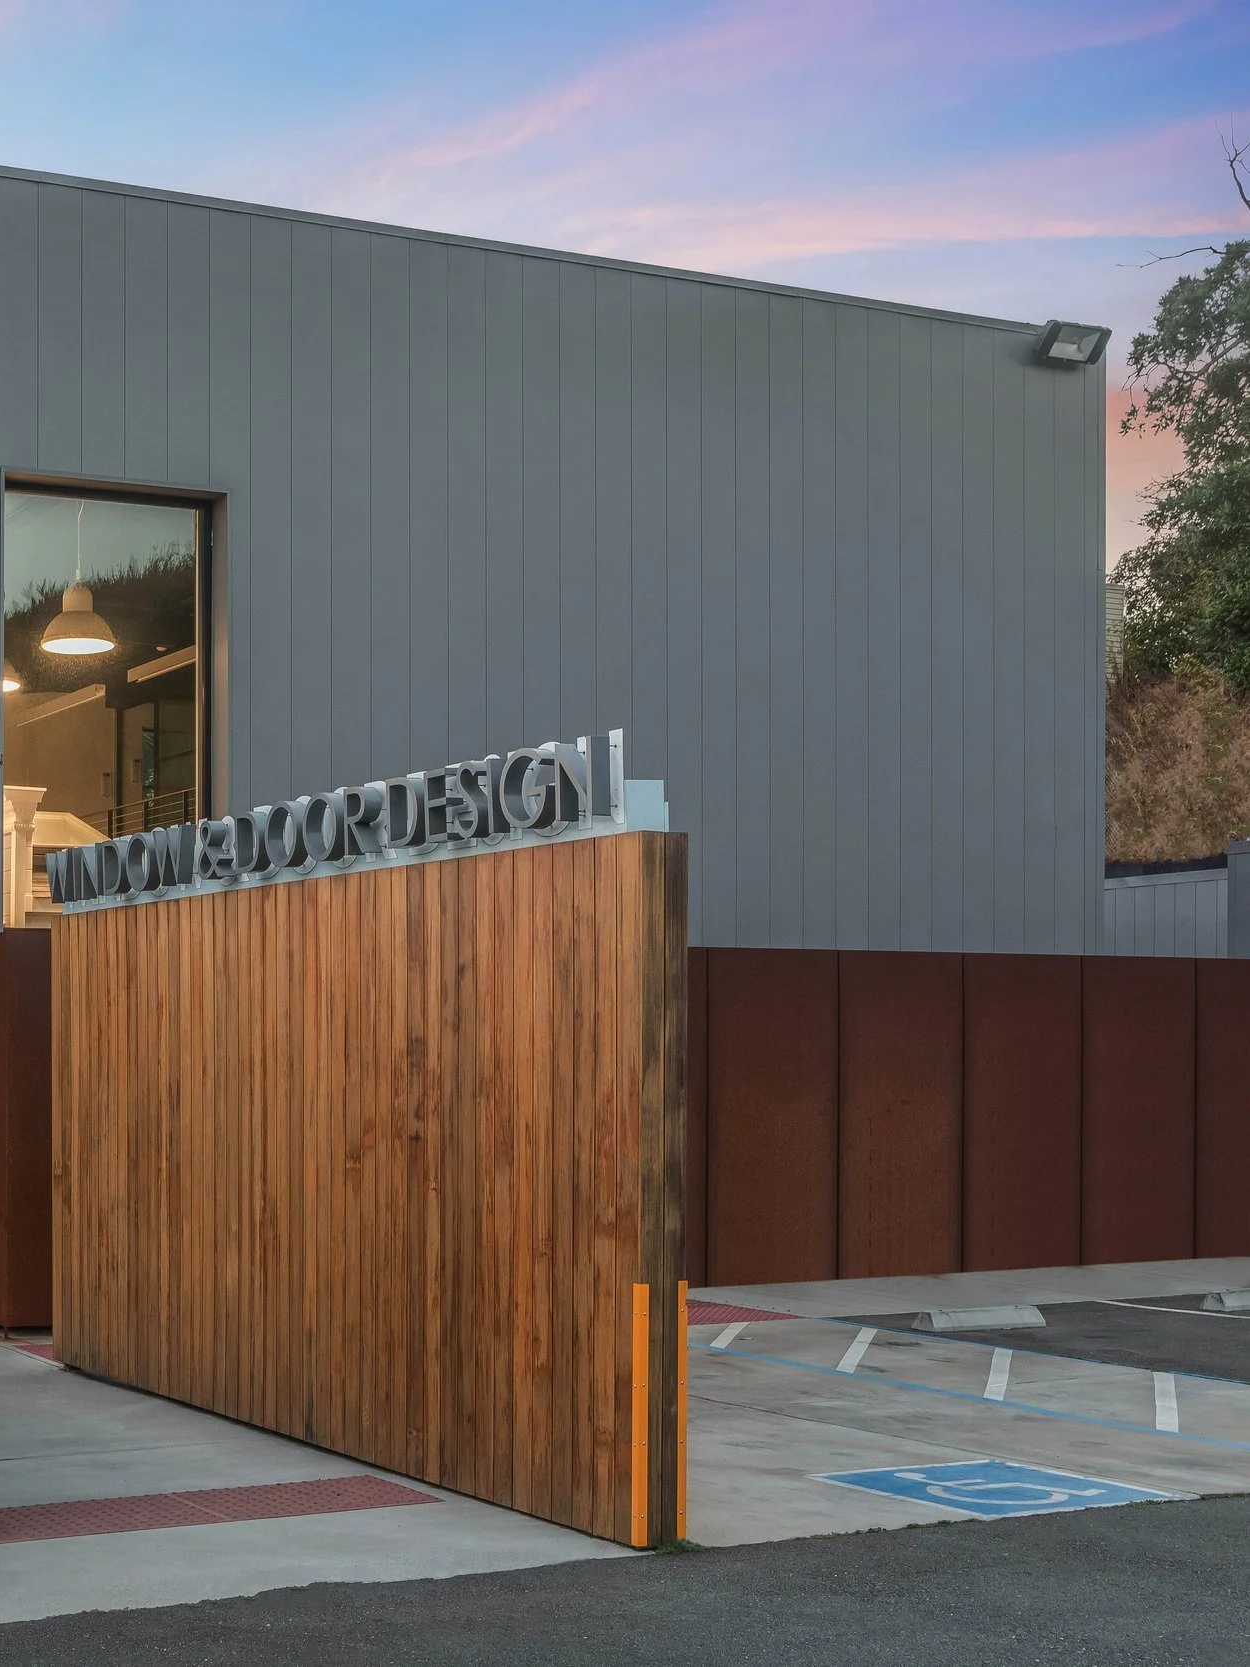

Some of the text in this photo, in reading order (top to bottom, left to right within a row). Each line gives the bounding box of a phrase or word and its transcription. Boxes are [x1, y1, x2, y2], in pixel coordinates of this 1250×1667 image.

[46, 735, 610, 903] WINDOW & DOOR DESIGN
